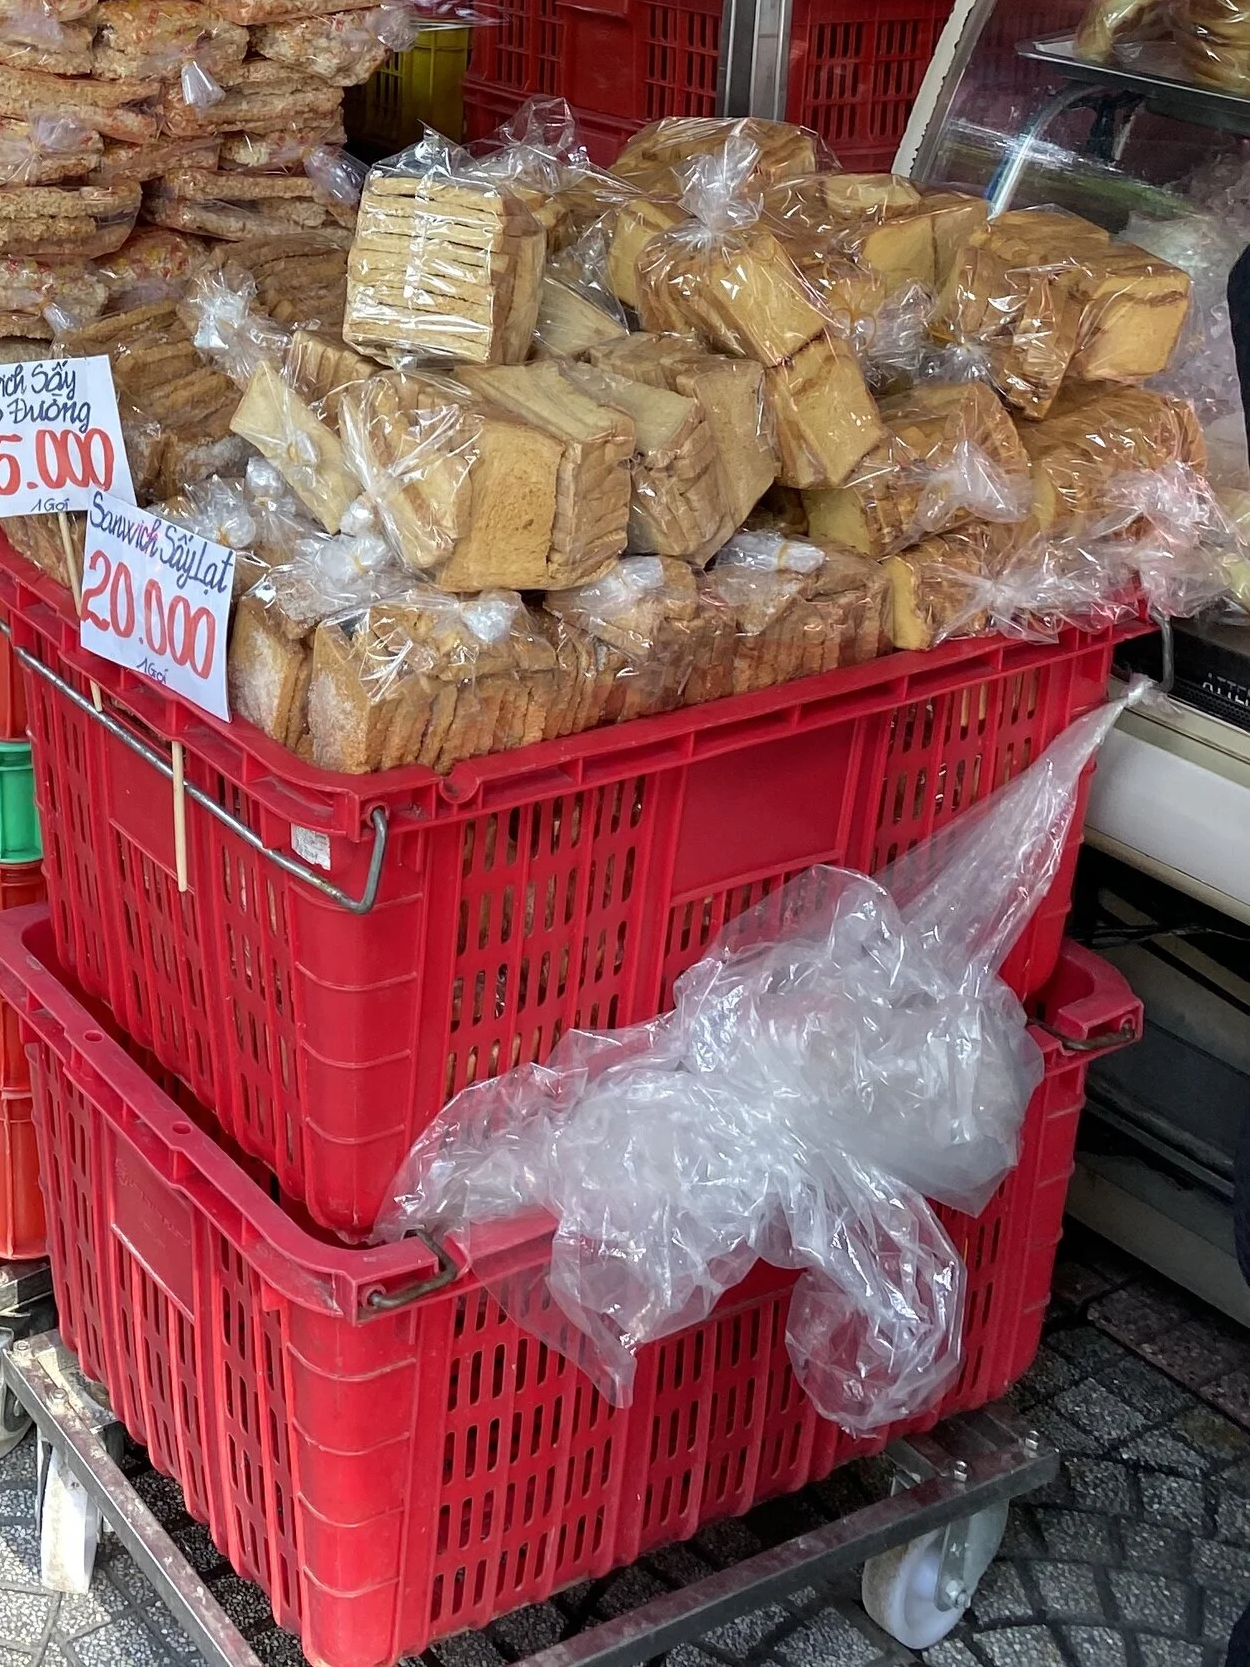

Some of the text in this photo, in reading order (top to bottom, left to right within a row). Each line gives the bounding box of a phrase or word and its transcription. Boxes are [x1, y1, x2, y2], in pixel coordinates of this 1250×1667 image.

[10, 393, 91, 433] Đường
[31, 361, 77, 401] Sấy
[89, 490, 160, 556] Sanwich
[161, 525, 198, 586] Sấy
[80, 549, 216, 680] 20.000
